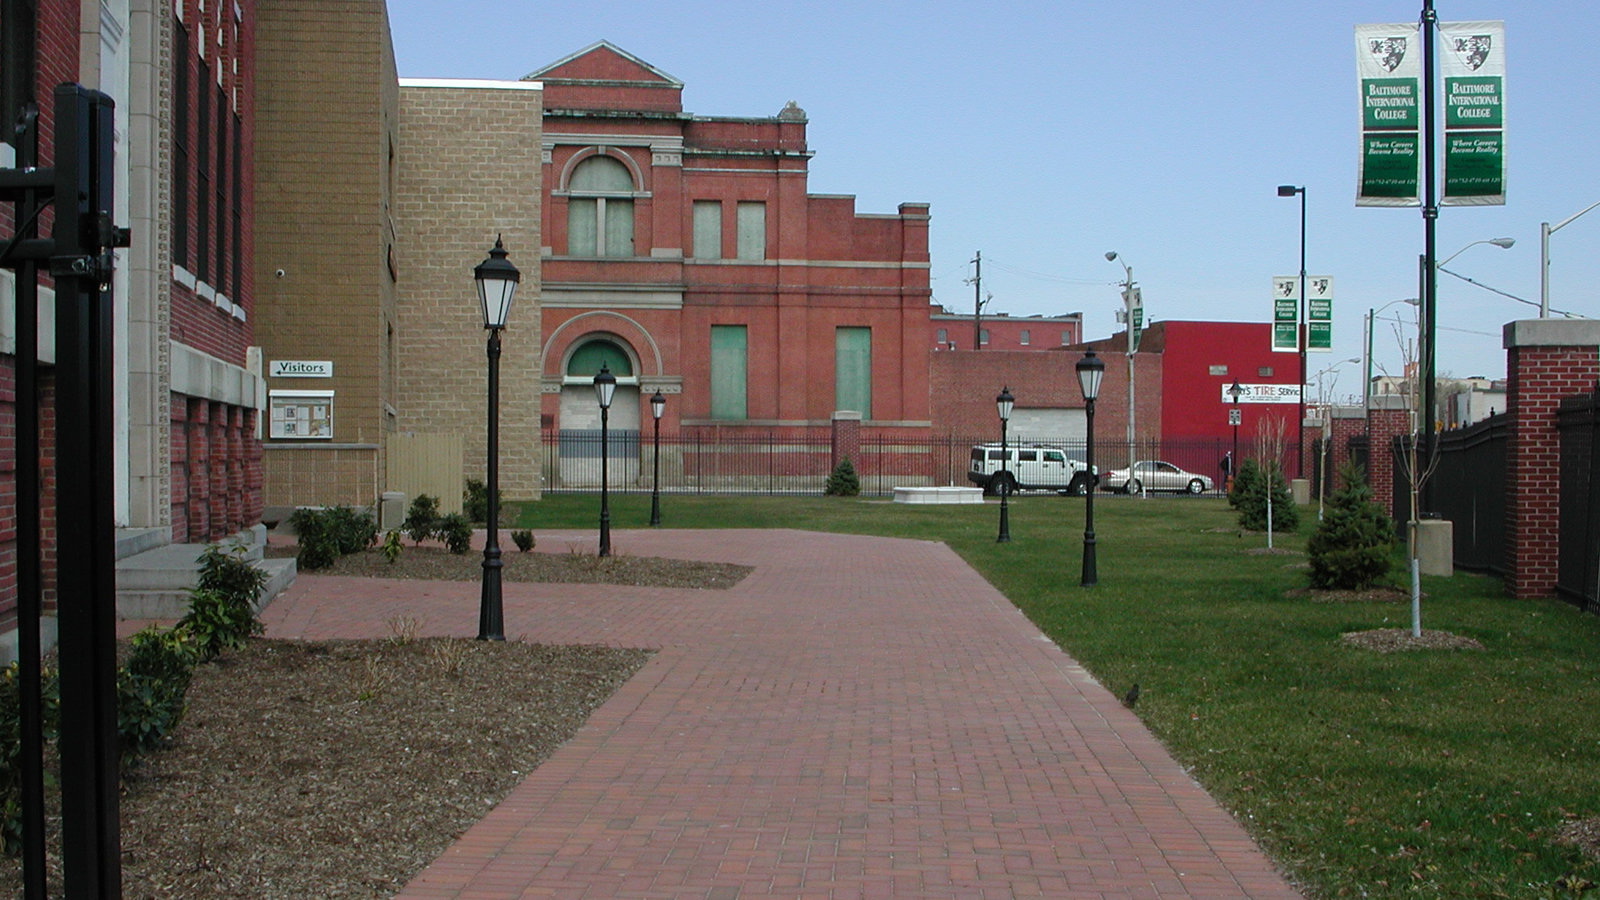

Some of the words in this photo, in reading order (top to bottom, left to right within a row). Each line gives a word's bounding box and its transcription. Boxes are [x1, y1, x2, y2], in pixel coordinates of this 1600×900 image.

[1369, 84, 1411, 96] BALTIMORE
[1452, 82, 1495, 95] BALTIMORE
[1366, 96, 1415, 107] INTERNATIONAL
[1449, 94, 1499, 106] INTERNATIONAL
[1374, 108, 1407, 120] COLLEGE
[1457, 106, 1491, 118] COLLEGE
[1392, 148, 1414, 156] Reality
[1476, 146, 1498, 154] Reality
[280, 362, 324, 372] Visitors
[1254, 386, 1276, 396] TIRE
[1278, 388, 1300, 396] SERVIC
